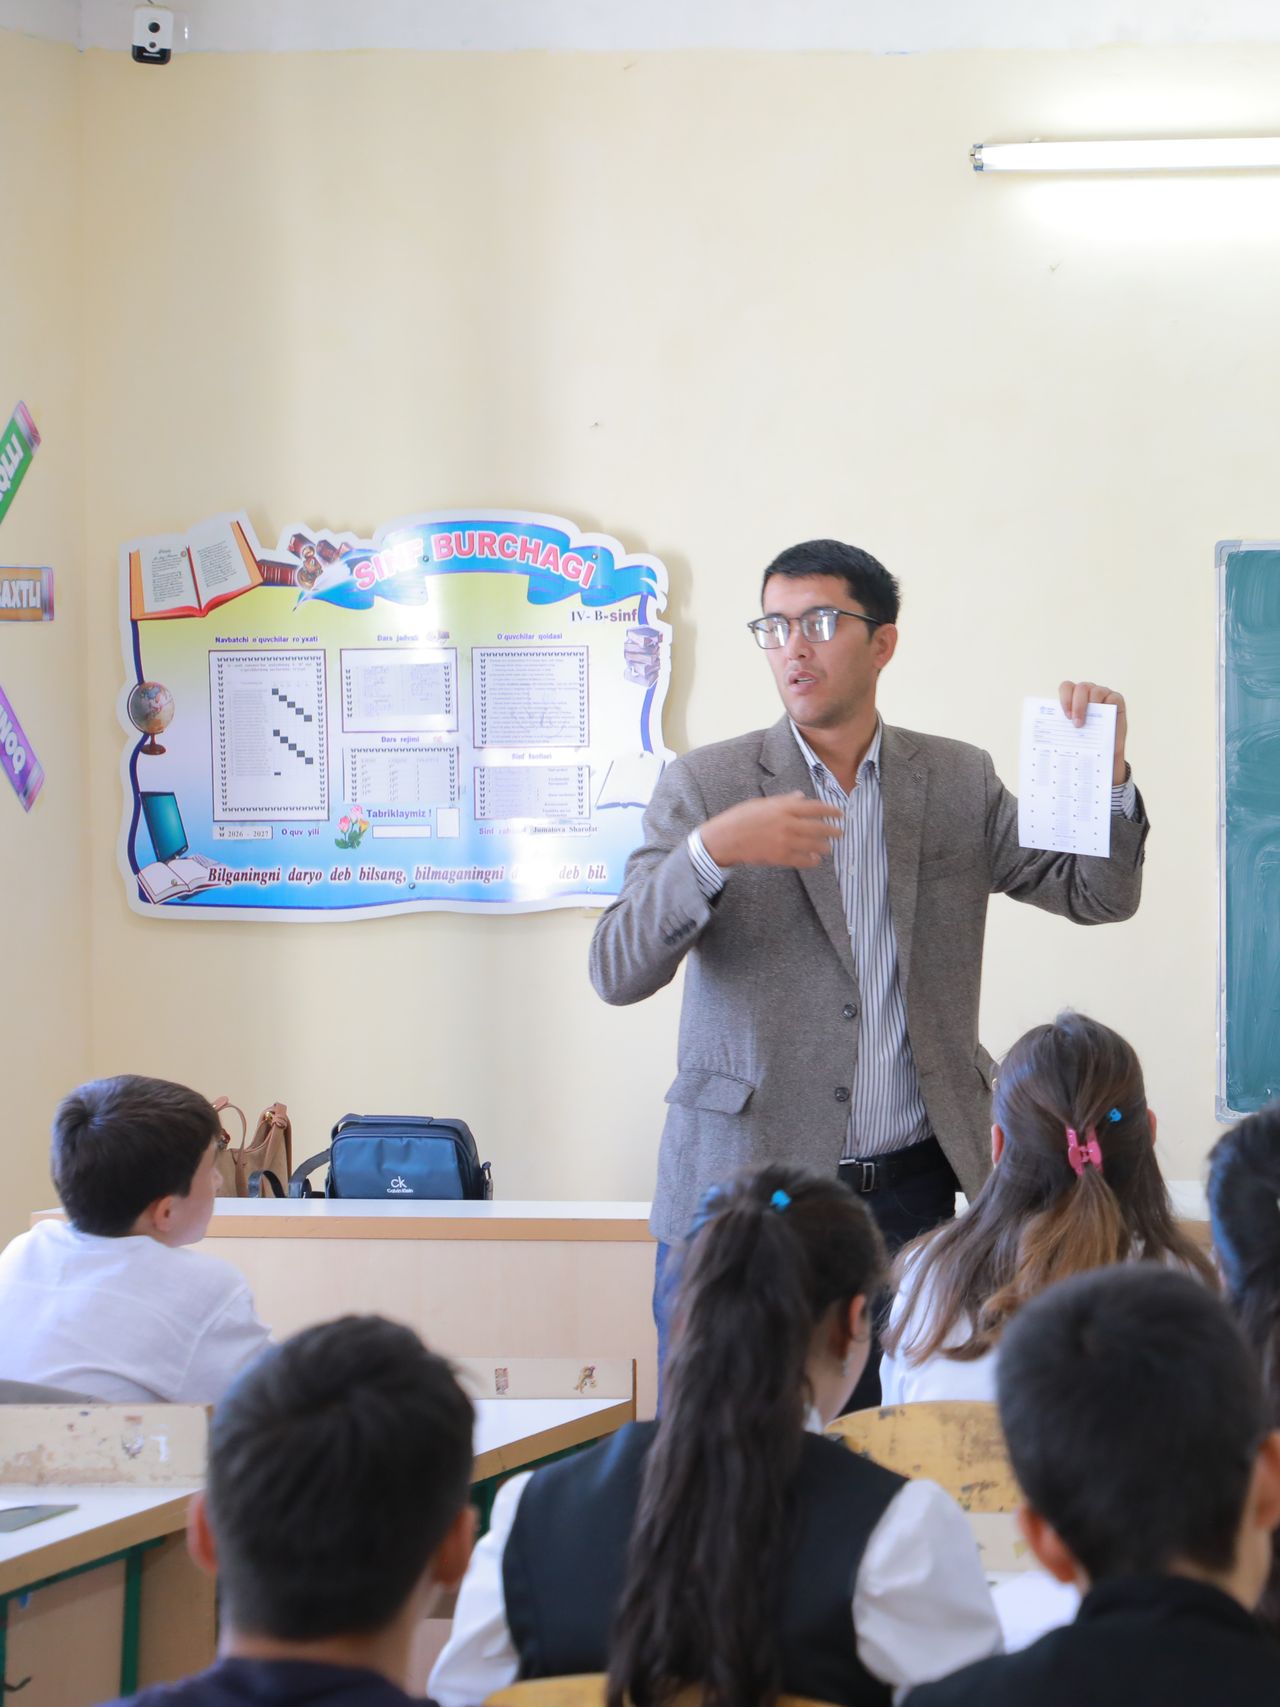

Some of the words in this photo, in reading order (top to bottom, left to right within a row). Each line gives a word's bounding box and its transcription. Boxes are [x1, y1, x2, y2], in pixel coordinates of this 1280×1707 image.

[431, 531, 596, 589] BURCHAGI
[366, 809, 426, 819] Tabriklaymiz
[208, 867, 281, 885] Bilganingni
[288, 867, 323, 885] daryo
[330, 867, 352, 881] deb
[359, 866, 407, 884] bilsang,
[415, 866, 504, 884] bilmaganingni
[559, 865, 580, 880] deb
[588, 865, 607, 879] bil.
